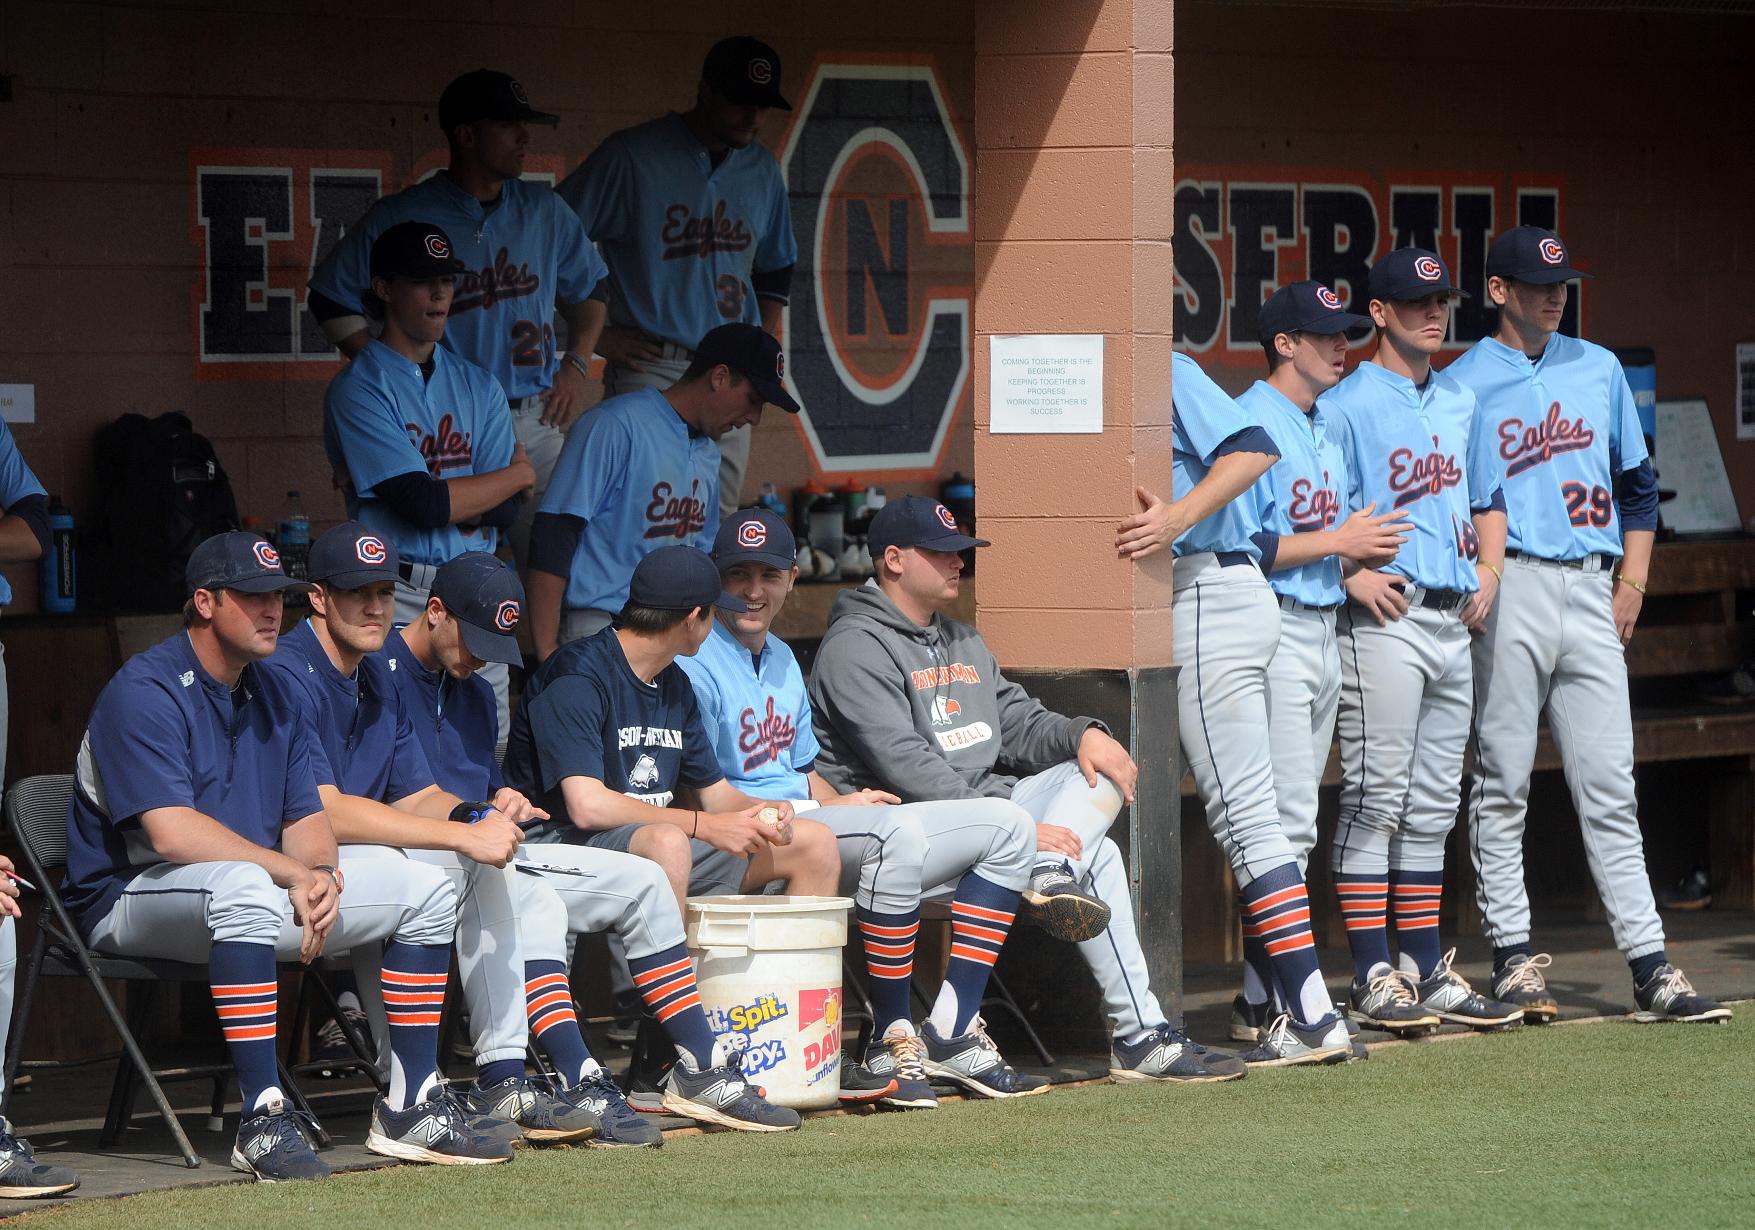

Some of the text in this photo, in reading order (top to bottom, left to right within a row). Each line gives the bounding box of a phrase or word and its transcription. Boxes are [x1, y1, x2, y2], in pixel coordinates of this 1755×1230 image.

[661, 199, 752, 261] Eagles
[450, 246, 540, 317] agles
[1001, 358, 1029, 366] COMING
[1027, 367, 1066, 375] BEGINNING
[1008, 378, 1038, 386] KEEPING
[1027, 387, 1066, 395] PROGRESS
[1006, 398, 1039, 406] WORKING
[1498, 400, 1594, 479] Eagles
[1388, 434, 1462, 511] Eages
[1561, 480, 1612, 528] 29
[947, 726, 985, 748] EBALL
[728, 992, 788, 1033] Spit.
[738, 1040, 787, 1077] ppy.
[803, 1022, 842, 1072] DAV
